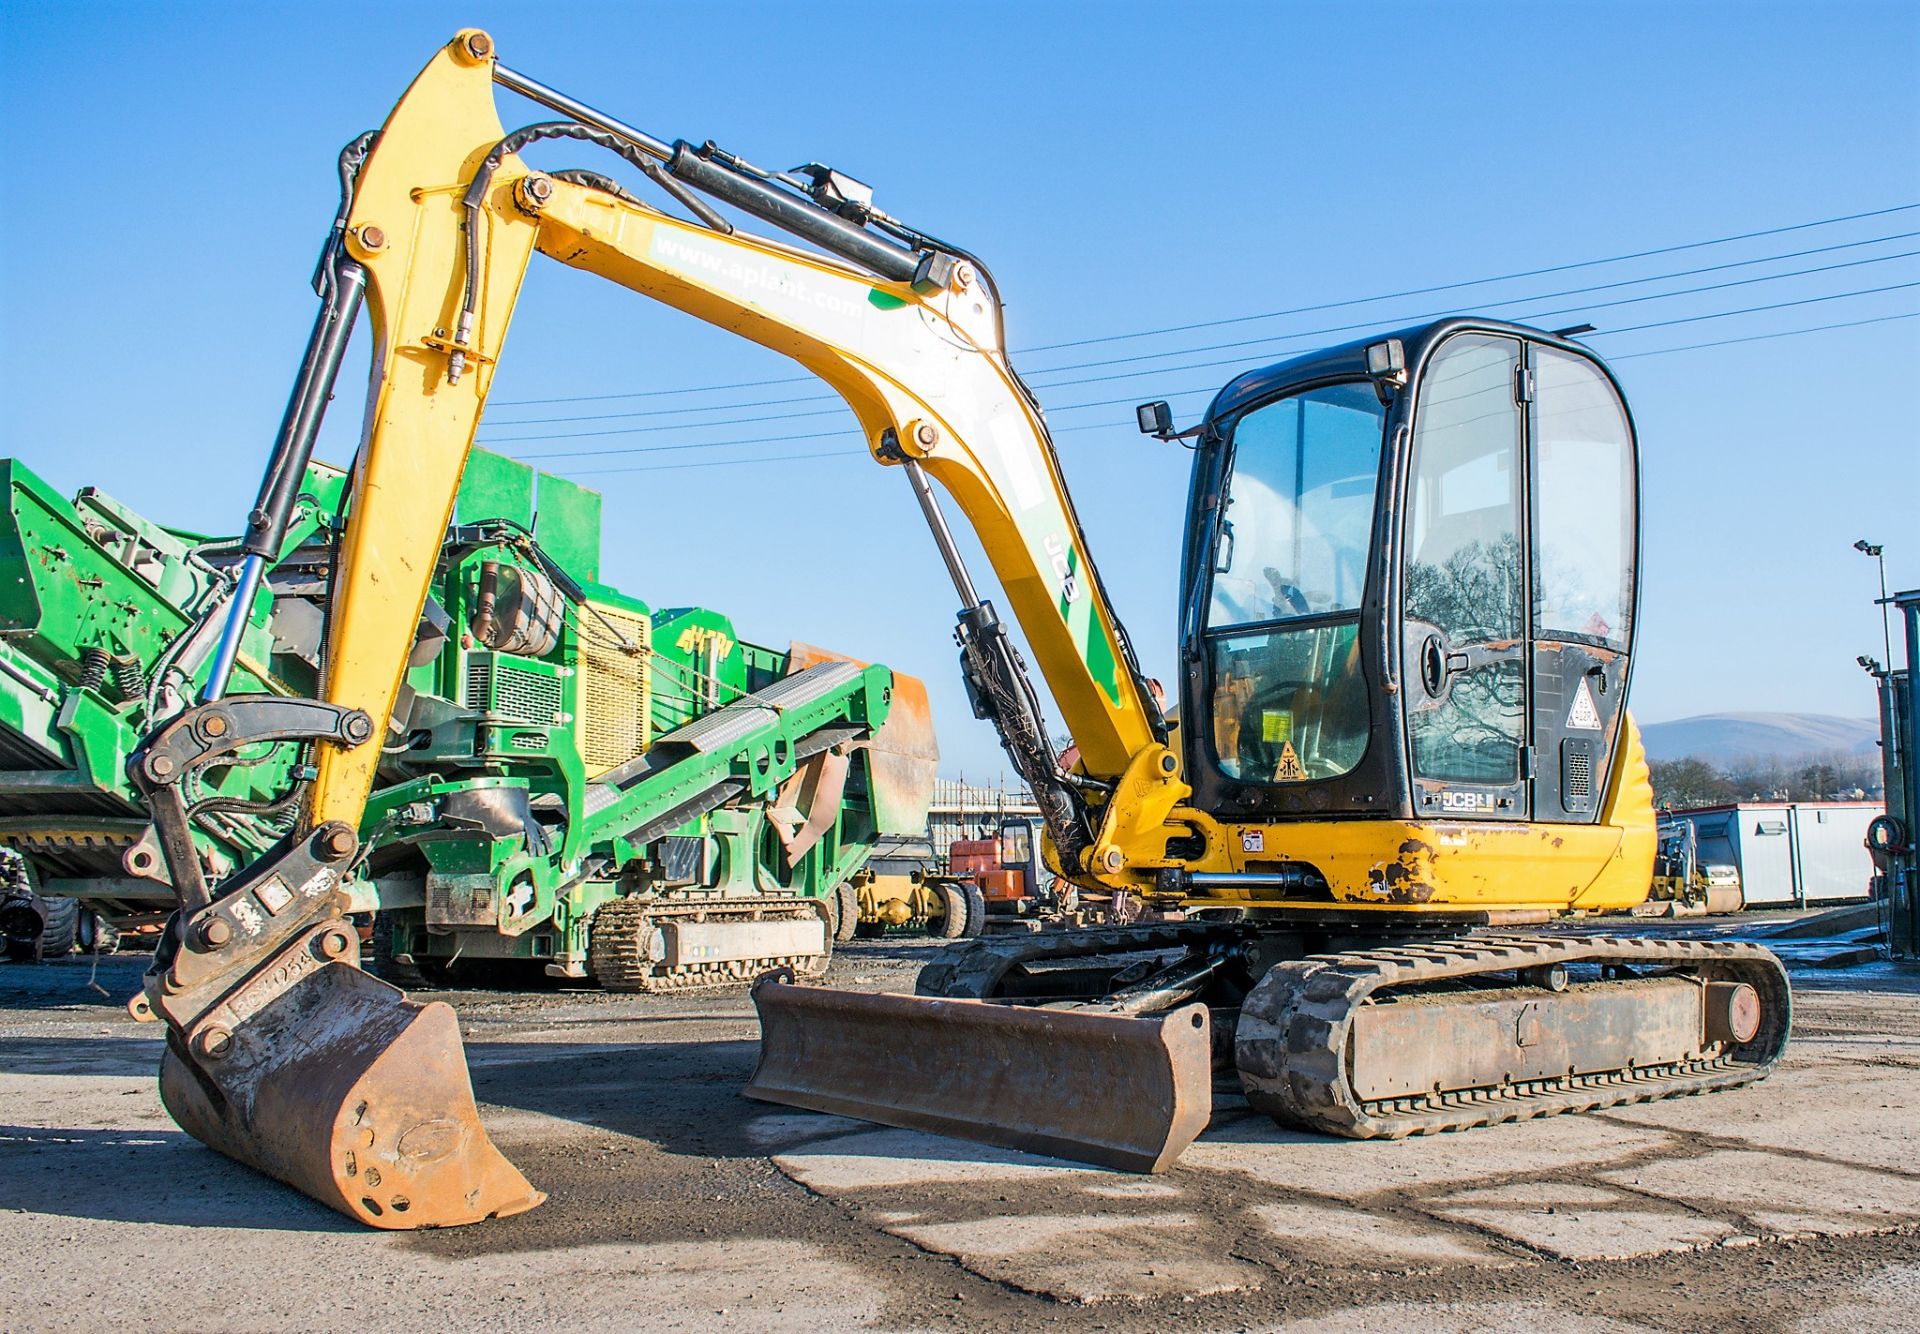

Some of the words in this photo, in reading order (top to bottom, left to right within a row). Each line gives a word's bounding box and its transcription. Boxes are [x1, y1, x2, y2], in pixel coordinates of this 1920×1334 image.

[656, 235, 863, 319] www.aplant.com
[1043, 531, 1081, 604] JCB
[1443, 792, 1477, 807] JCB
